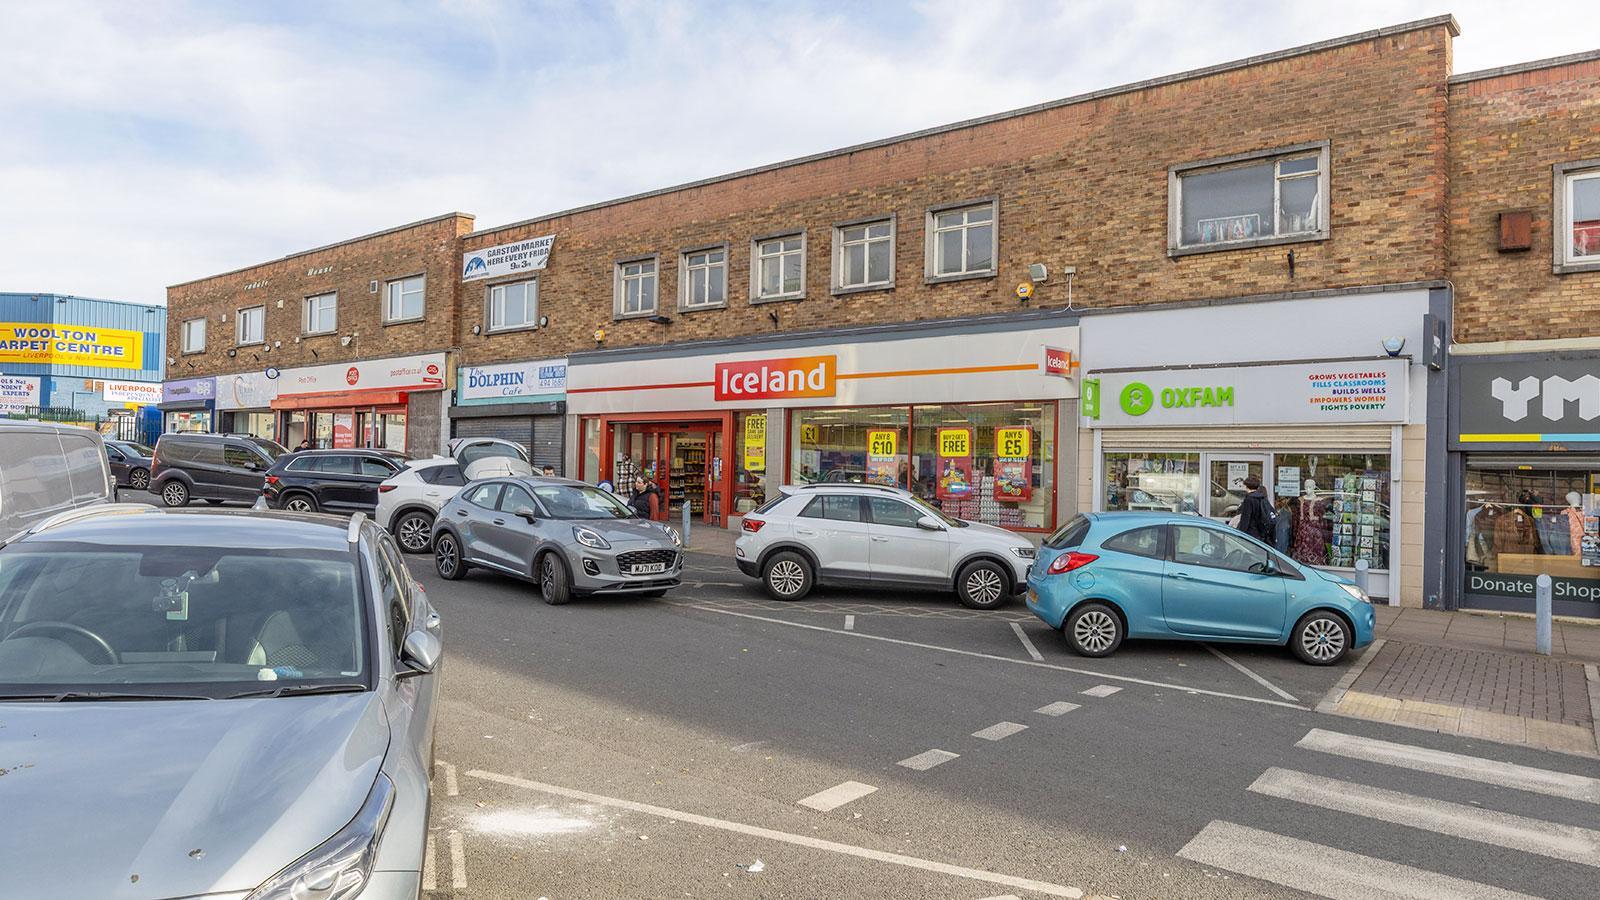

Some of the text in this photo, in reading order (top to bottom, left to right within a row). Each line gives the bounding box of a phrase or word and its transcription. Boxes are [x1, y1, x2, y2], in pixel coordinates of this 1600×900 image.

[487, 245, 520, 258] GARSTON
[487, 257, 504, 266] HERE
[505, 252, 528, 262] EVERY
[14, 328, 97, 342] WOOLTON
[55, 342, 124, 356] CENTRE
[1047, 355, 1070, 370] Iceland
[469, 367, 484, 376] The
[722, 362, 826, 395] Iceland
[1338, 372, 1386, 380] VEGETABLES
[468, 371, 525, 389] DOLPHIN
[1333, 379, 1386, 388] CLASSROOMS
[109, 384, 157, 394] LIVERPOOL
[502, 386, 523, 396] Cafe
[1161, 386, 1234, 409] OXFAM
[1354, 395, 1386, 403] WOMEN
[1491, 374, 1600, 422] YM
[747, 418, 765, 429] FREE
[1005, 431, 1023, 439] ANY 5
[872, 440, 893, 455] £10
[943, 440, 966, 453] FREE
[1004, 439, 1022, 455] £5
[1471, 576, 1600, 601] Donate Shop
